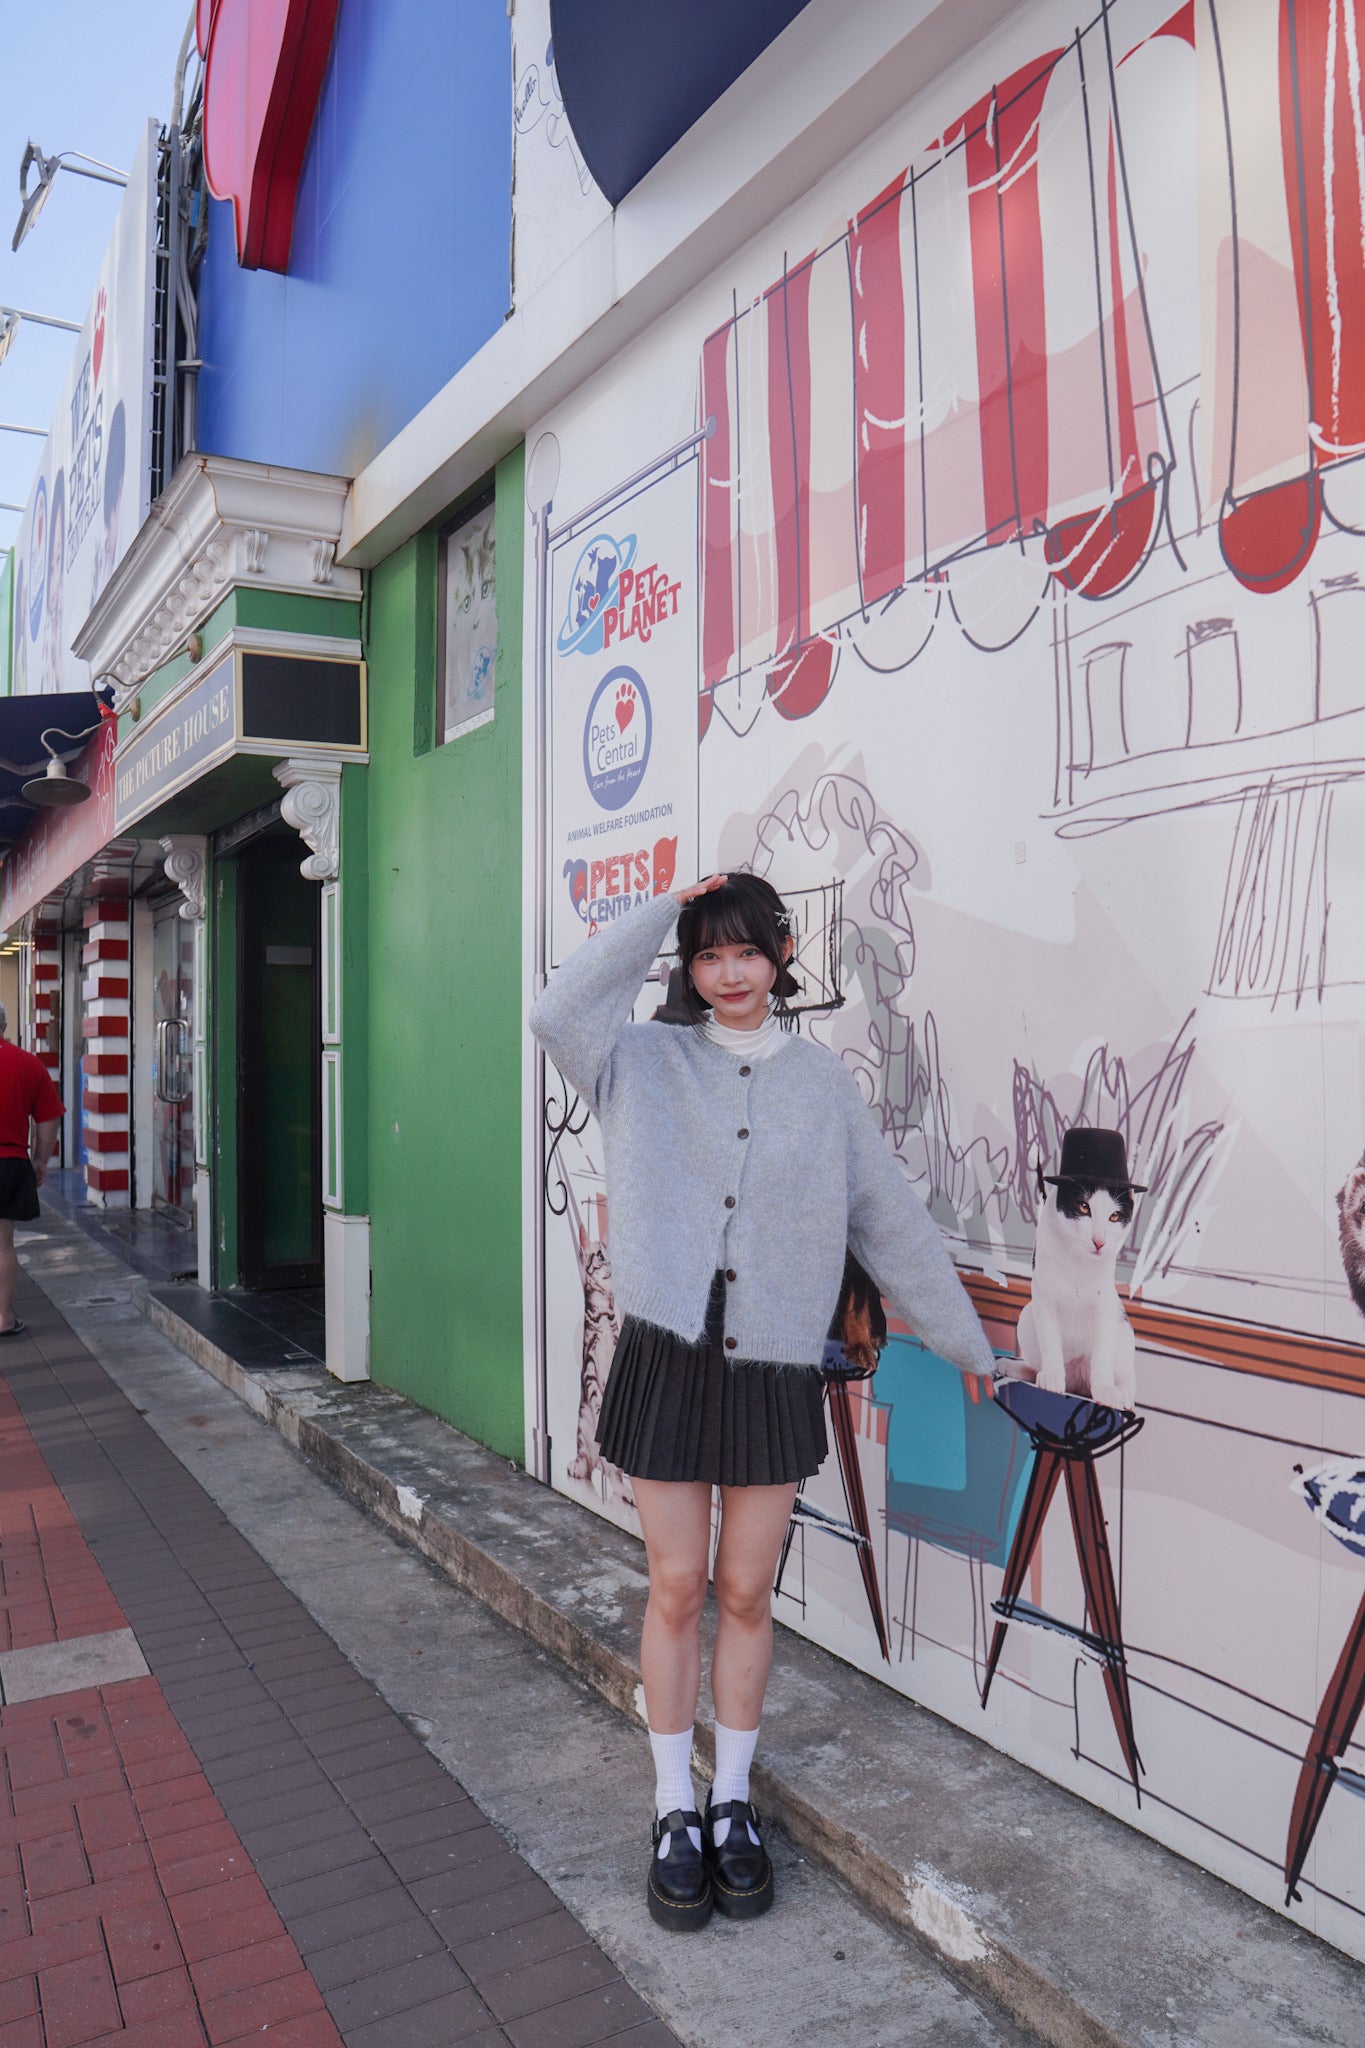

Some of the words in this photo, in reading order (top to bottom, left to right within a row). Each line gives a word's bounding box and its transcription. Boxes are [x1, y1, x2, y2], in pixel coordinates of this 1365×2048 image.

[71, 348, 91, 453] WE
[67, 388, 103, 539] PETS
[603, 573, 682, 650] PLANET
[618, 563, 658, 611] PET
[117, 770, 135, 804] THE
[135, 726, 181, 792] PICTURE
[182, 684, 230, 753] HOUSE
[591, 725, 615, 752] Pets
[597, 733, 638, 771] Central
[567, 827, 592, 842] ANIMAL
[592, 817, 624, 835] WELFARE
[624, 803, 673, 827] FOUNDATION
[590, 849, 650, 900] PETS
